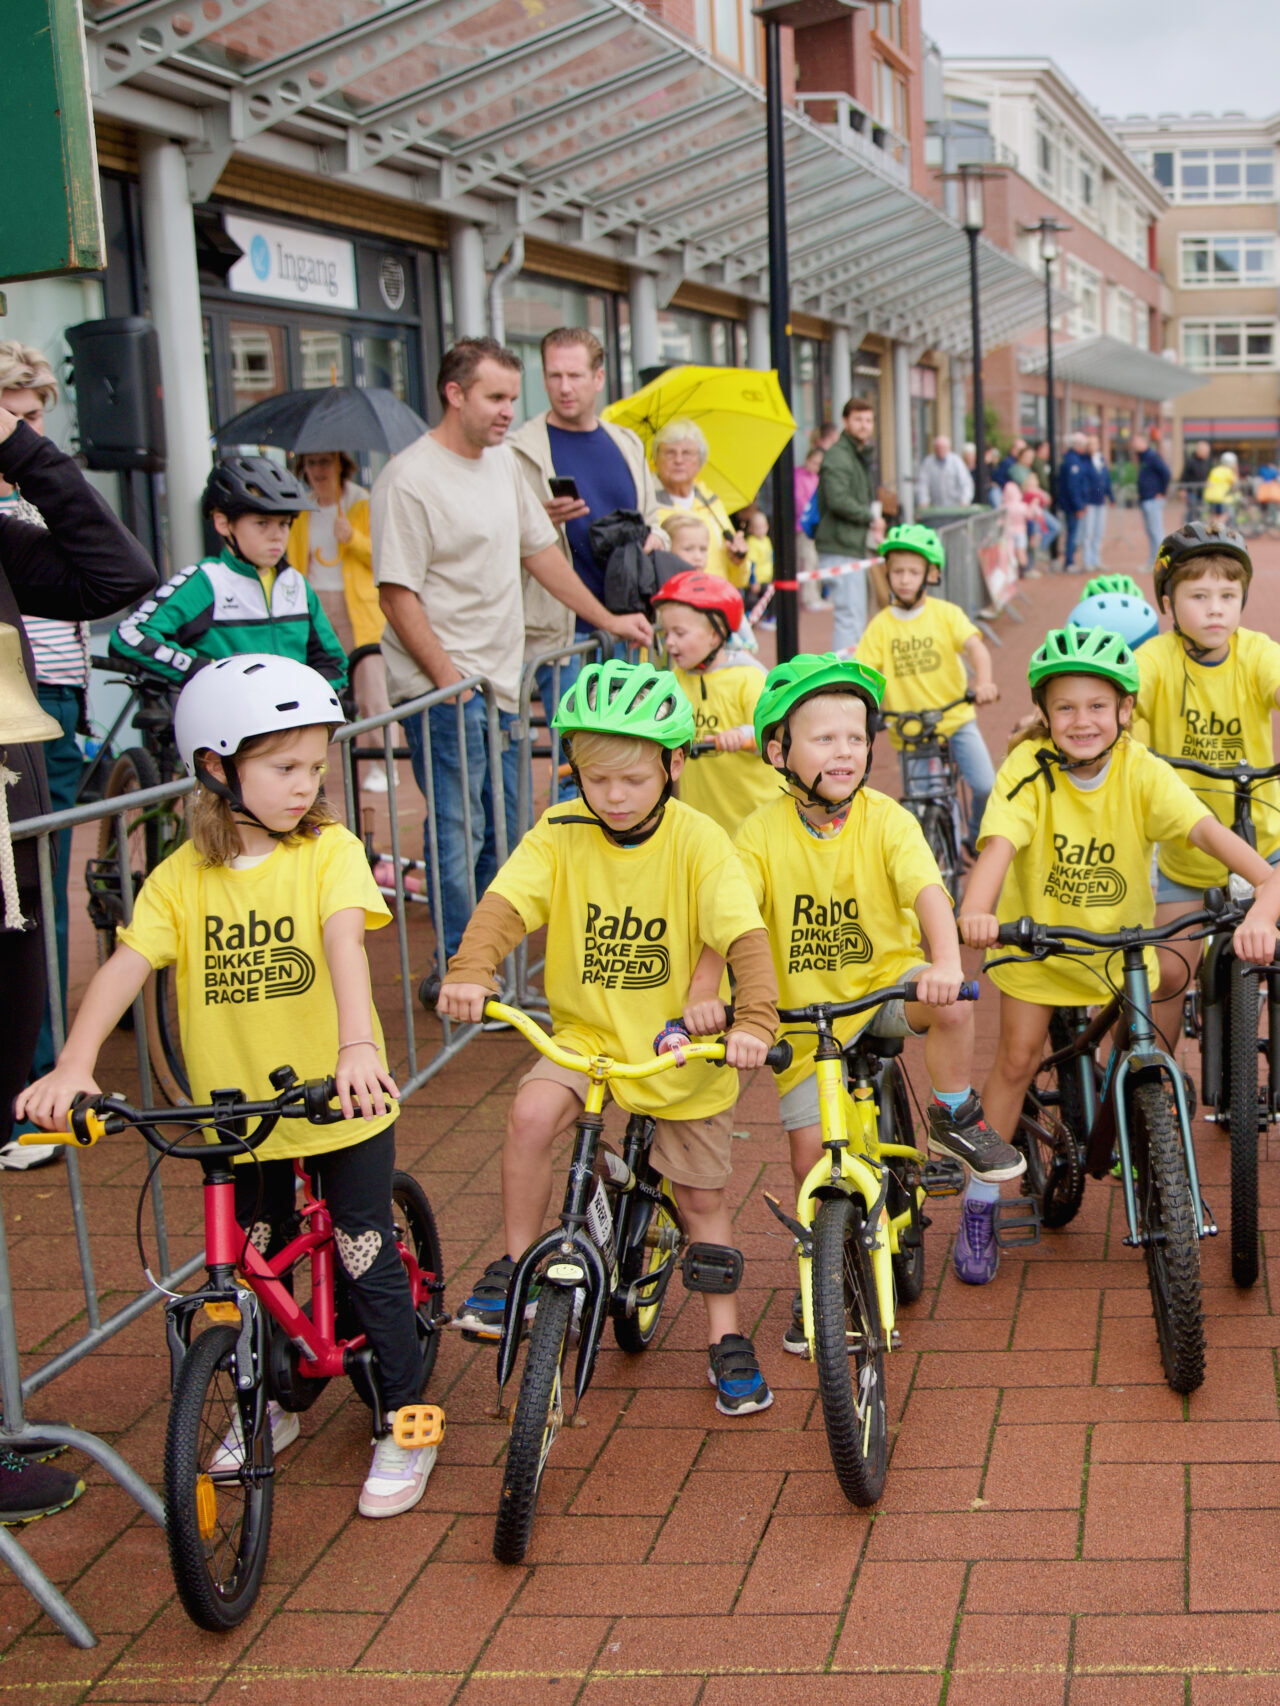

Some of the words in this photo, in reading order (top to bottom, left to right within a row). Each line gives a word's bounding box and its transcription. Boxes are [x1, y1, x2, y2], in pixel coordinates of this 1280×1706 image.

[277, 242, 338, 296] Ingang
[891, 635, 934, 654] Rabo
[1186, 709, 1242, 736] Rabo
[1181, 745, 1237, 760] BANDEN
[1053, 832, 1115, 866] Rabo
[585, 902, 667, 941] Rabo
[793, 893, 858, 927] Rabo
[205, 910, 294, 951] Rabo
[791, 927, 840, 943] DIKKE
[790, 937, 858, 959] BANDEN
[205, 950, 265, 970] DIKKE
[788, 958, 837, 974] RACE
[205, 963, 292, 988] BANDEN
[205, 986, 259, 1006] RACE
